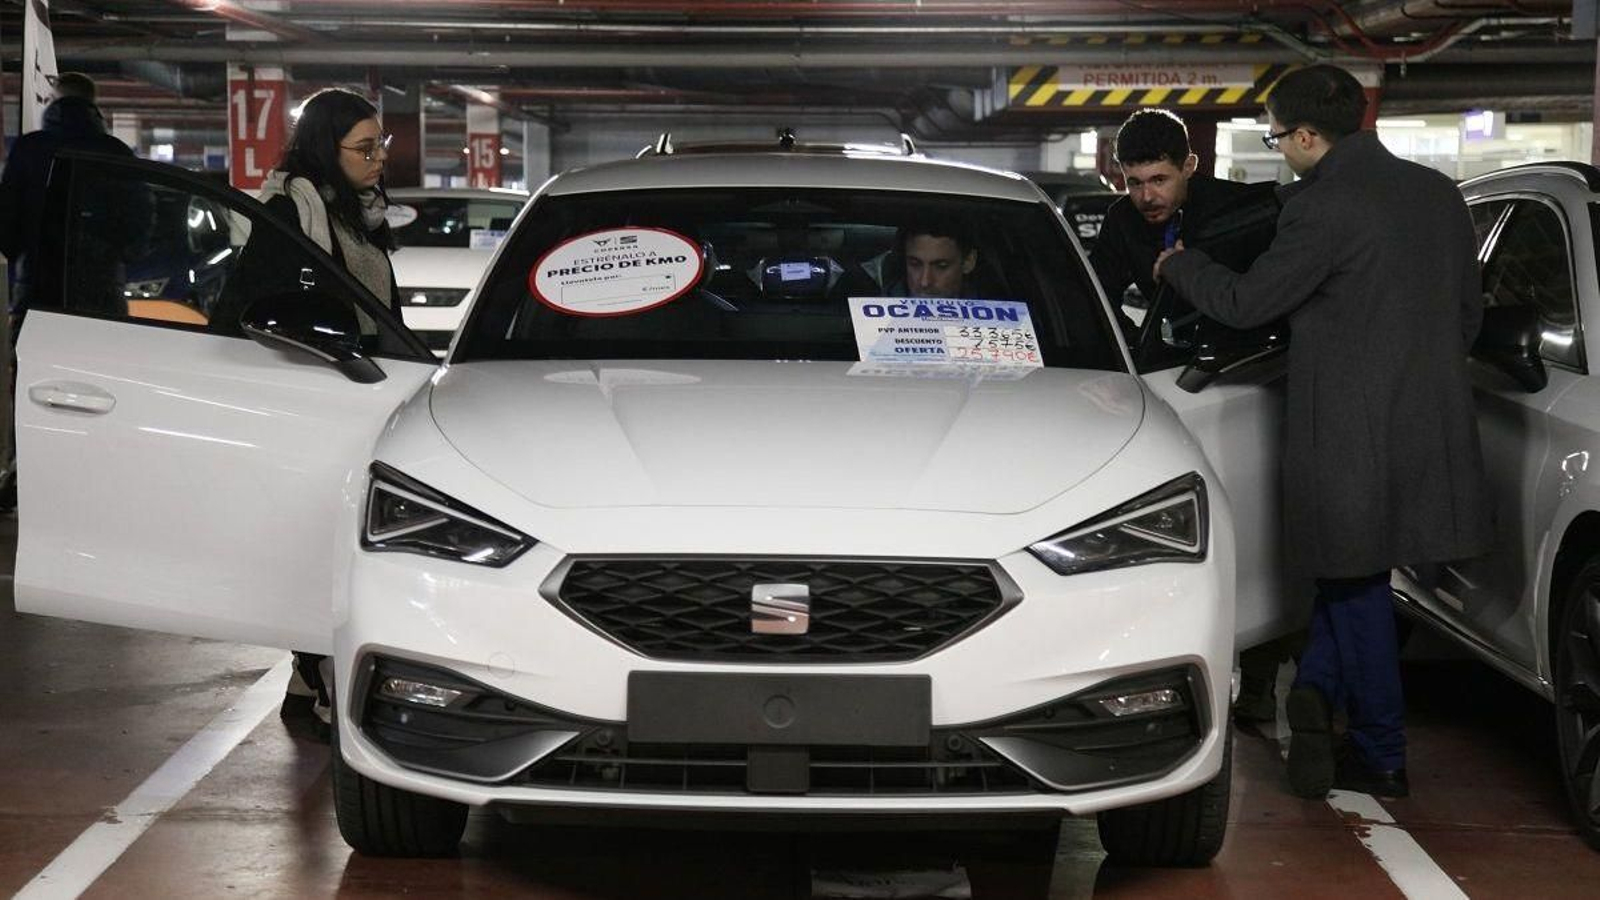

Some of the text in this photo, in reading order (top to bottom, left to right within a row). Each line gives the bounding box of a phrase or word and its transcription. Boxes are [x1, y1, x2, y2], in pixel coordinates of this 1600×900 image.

[1083, 73, 1182, 86] PERMITIDA
[1187, 74, 1197, 85] 2
[232, 89, 275, 140] 17
[472, 138, 495, 169] 15
[245, 147, 263, 177] L
[547, 263, 614, 278] PRECIO
[618, 260, 641, 268] DE
[877, 326, 894, 334] PVP
[894, 337, 943, 345] DESCUENTO
[894, 347, 945, 355] OFERTA
